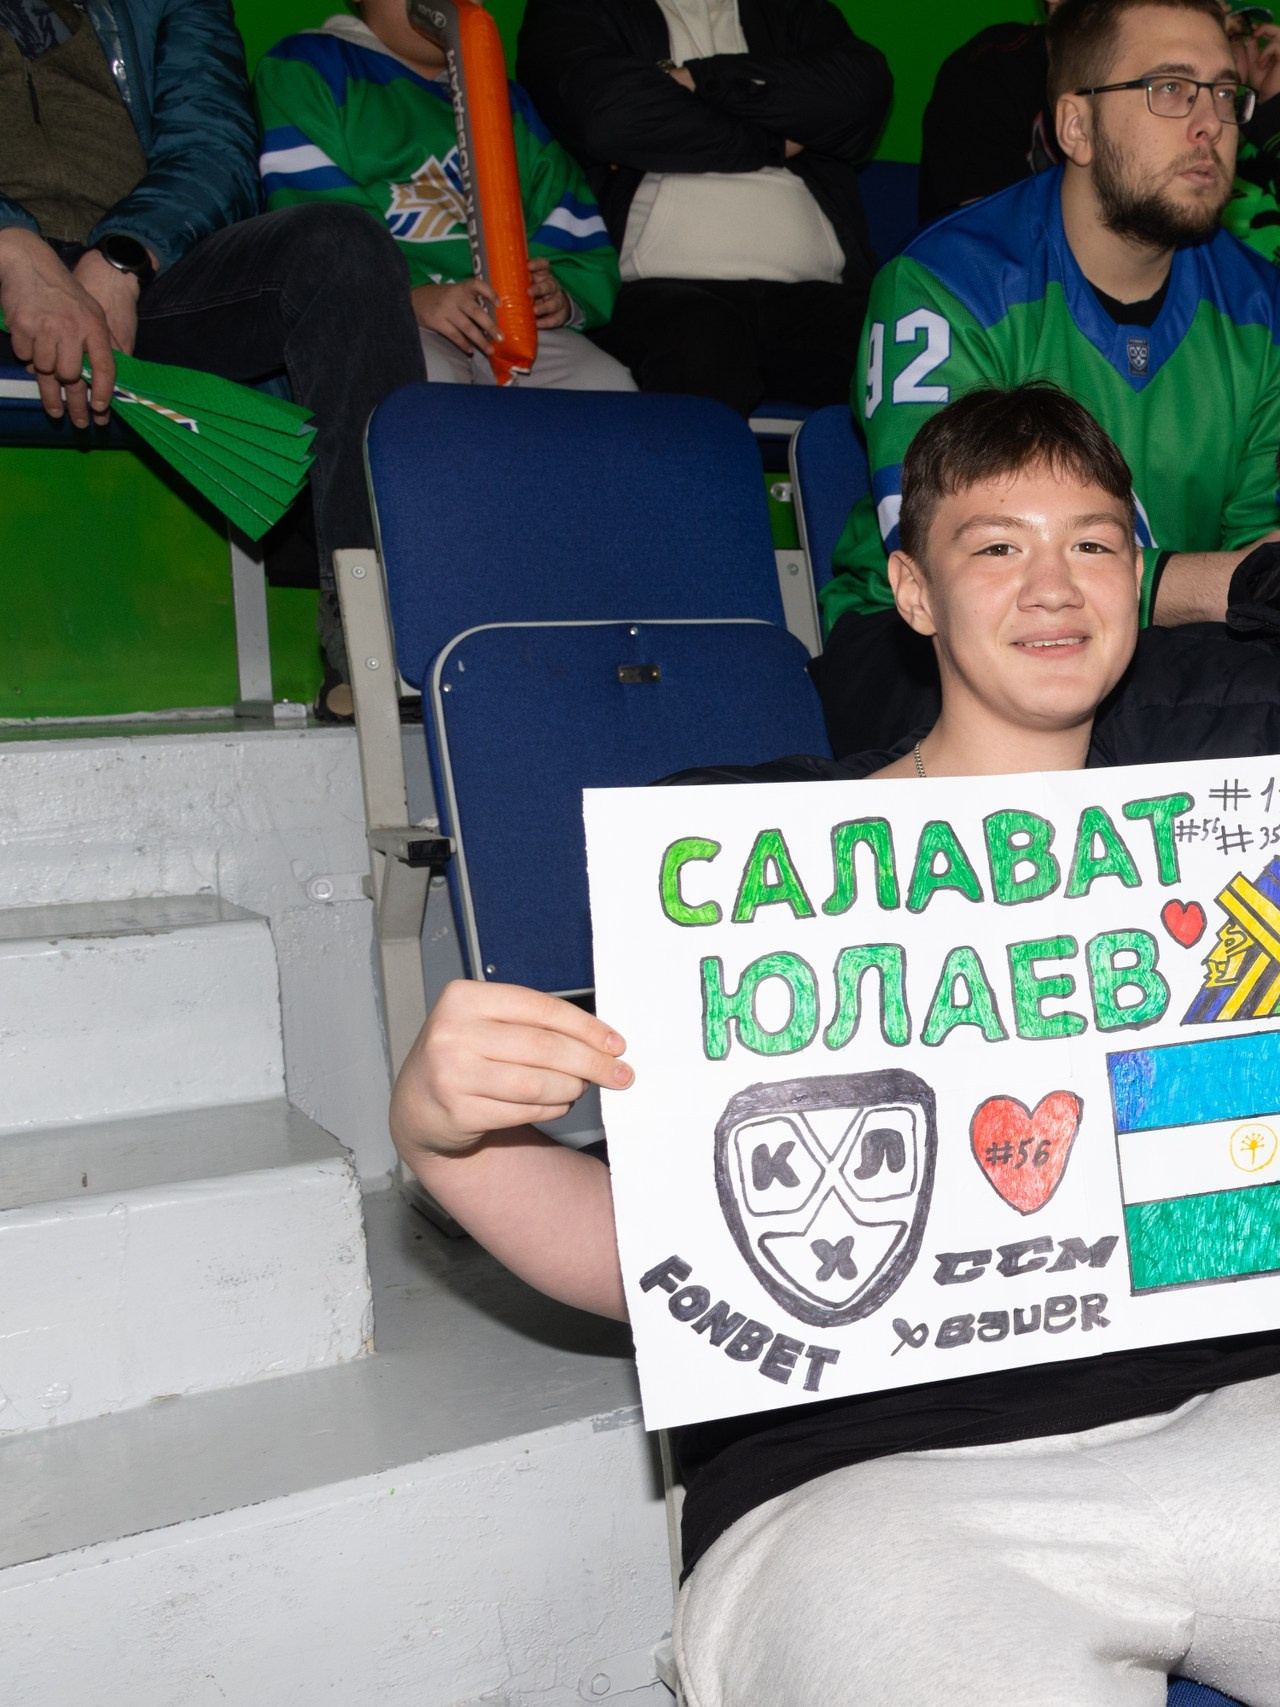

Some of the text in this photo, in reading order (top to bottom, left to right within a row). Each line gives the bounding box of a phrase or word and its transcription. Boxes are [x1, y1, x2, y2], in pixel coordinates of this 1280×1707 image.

[659, 792, 1195, 927] САЛАВАТ
[1175, 817, 1220, 842] #56
[700, 928, 1171, 1061] ЮЛАЕВ
[984, 1137, 1052, 1169] #56
[933, 1235, 1119, 1286] CCM
[639, 1254, 841, 1392] FONBET
